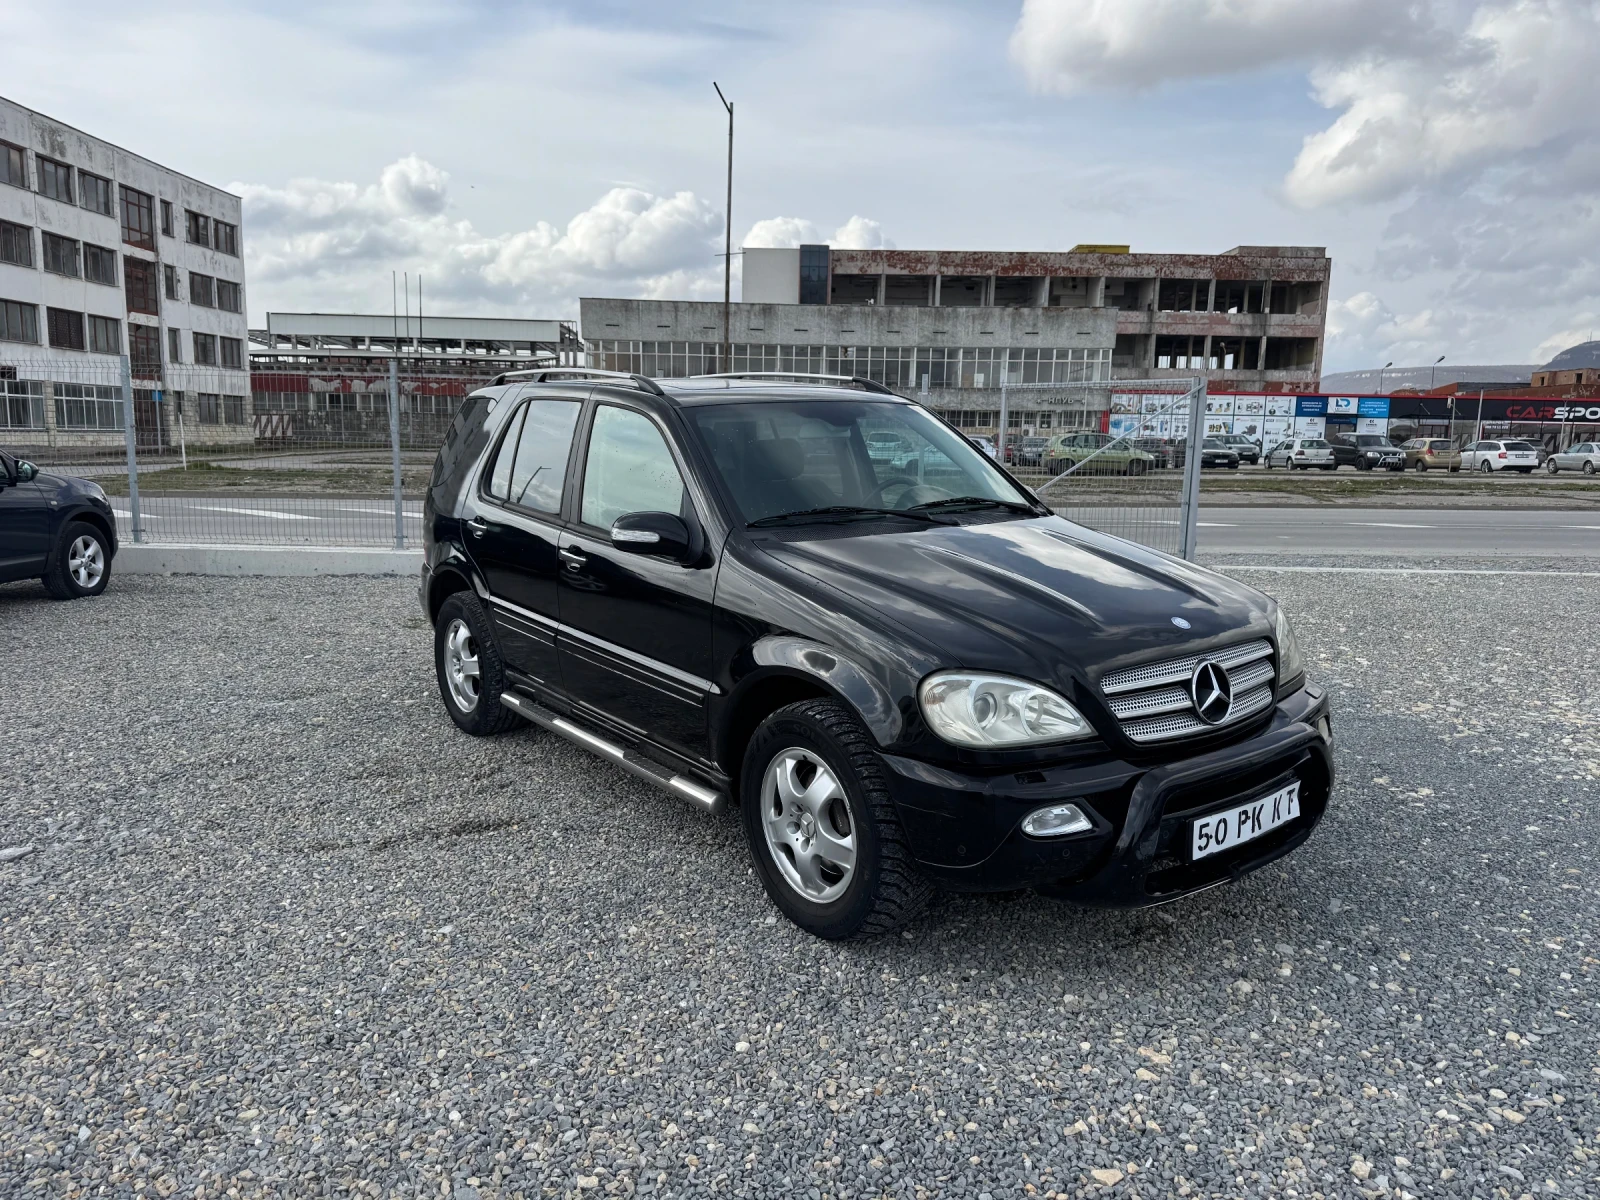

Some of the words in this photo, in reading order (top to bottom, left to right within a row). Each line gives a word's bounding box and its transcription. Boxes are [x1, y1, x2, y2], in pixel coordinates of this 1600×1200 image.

[1506, 406, 1600, 419] CARSPO
[1197, 818, 1228, 851] 50
[1237, 803, 1265, 839] PK
